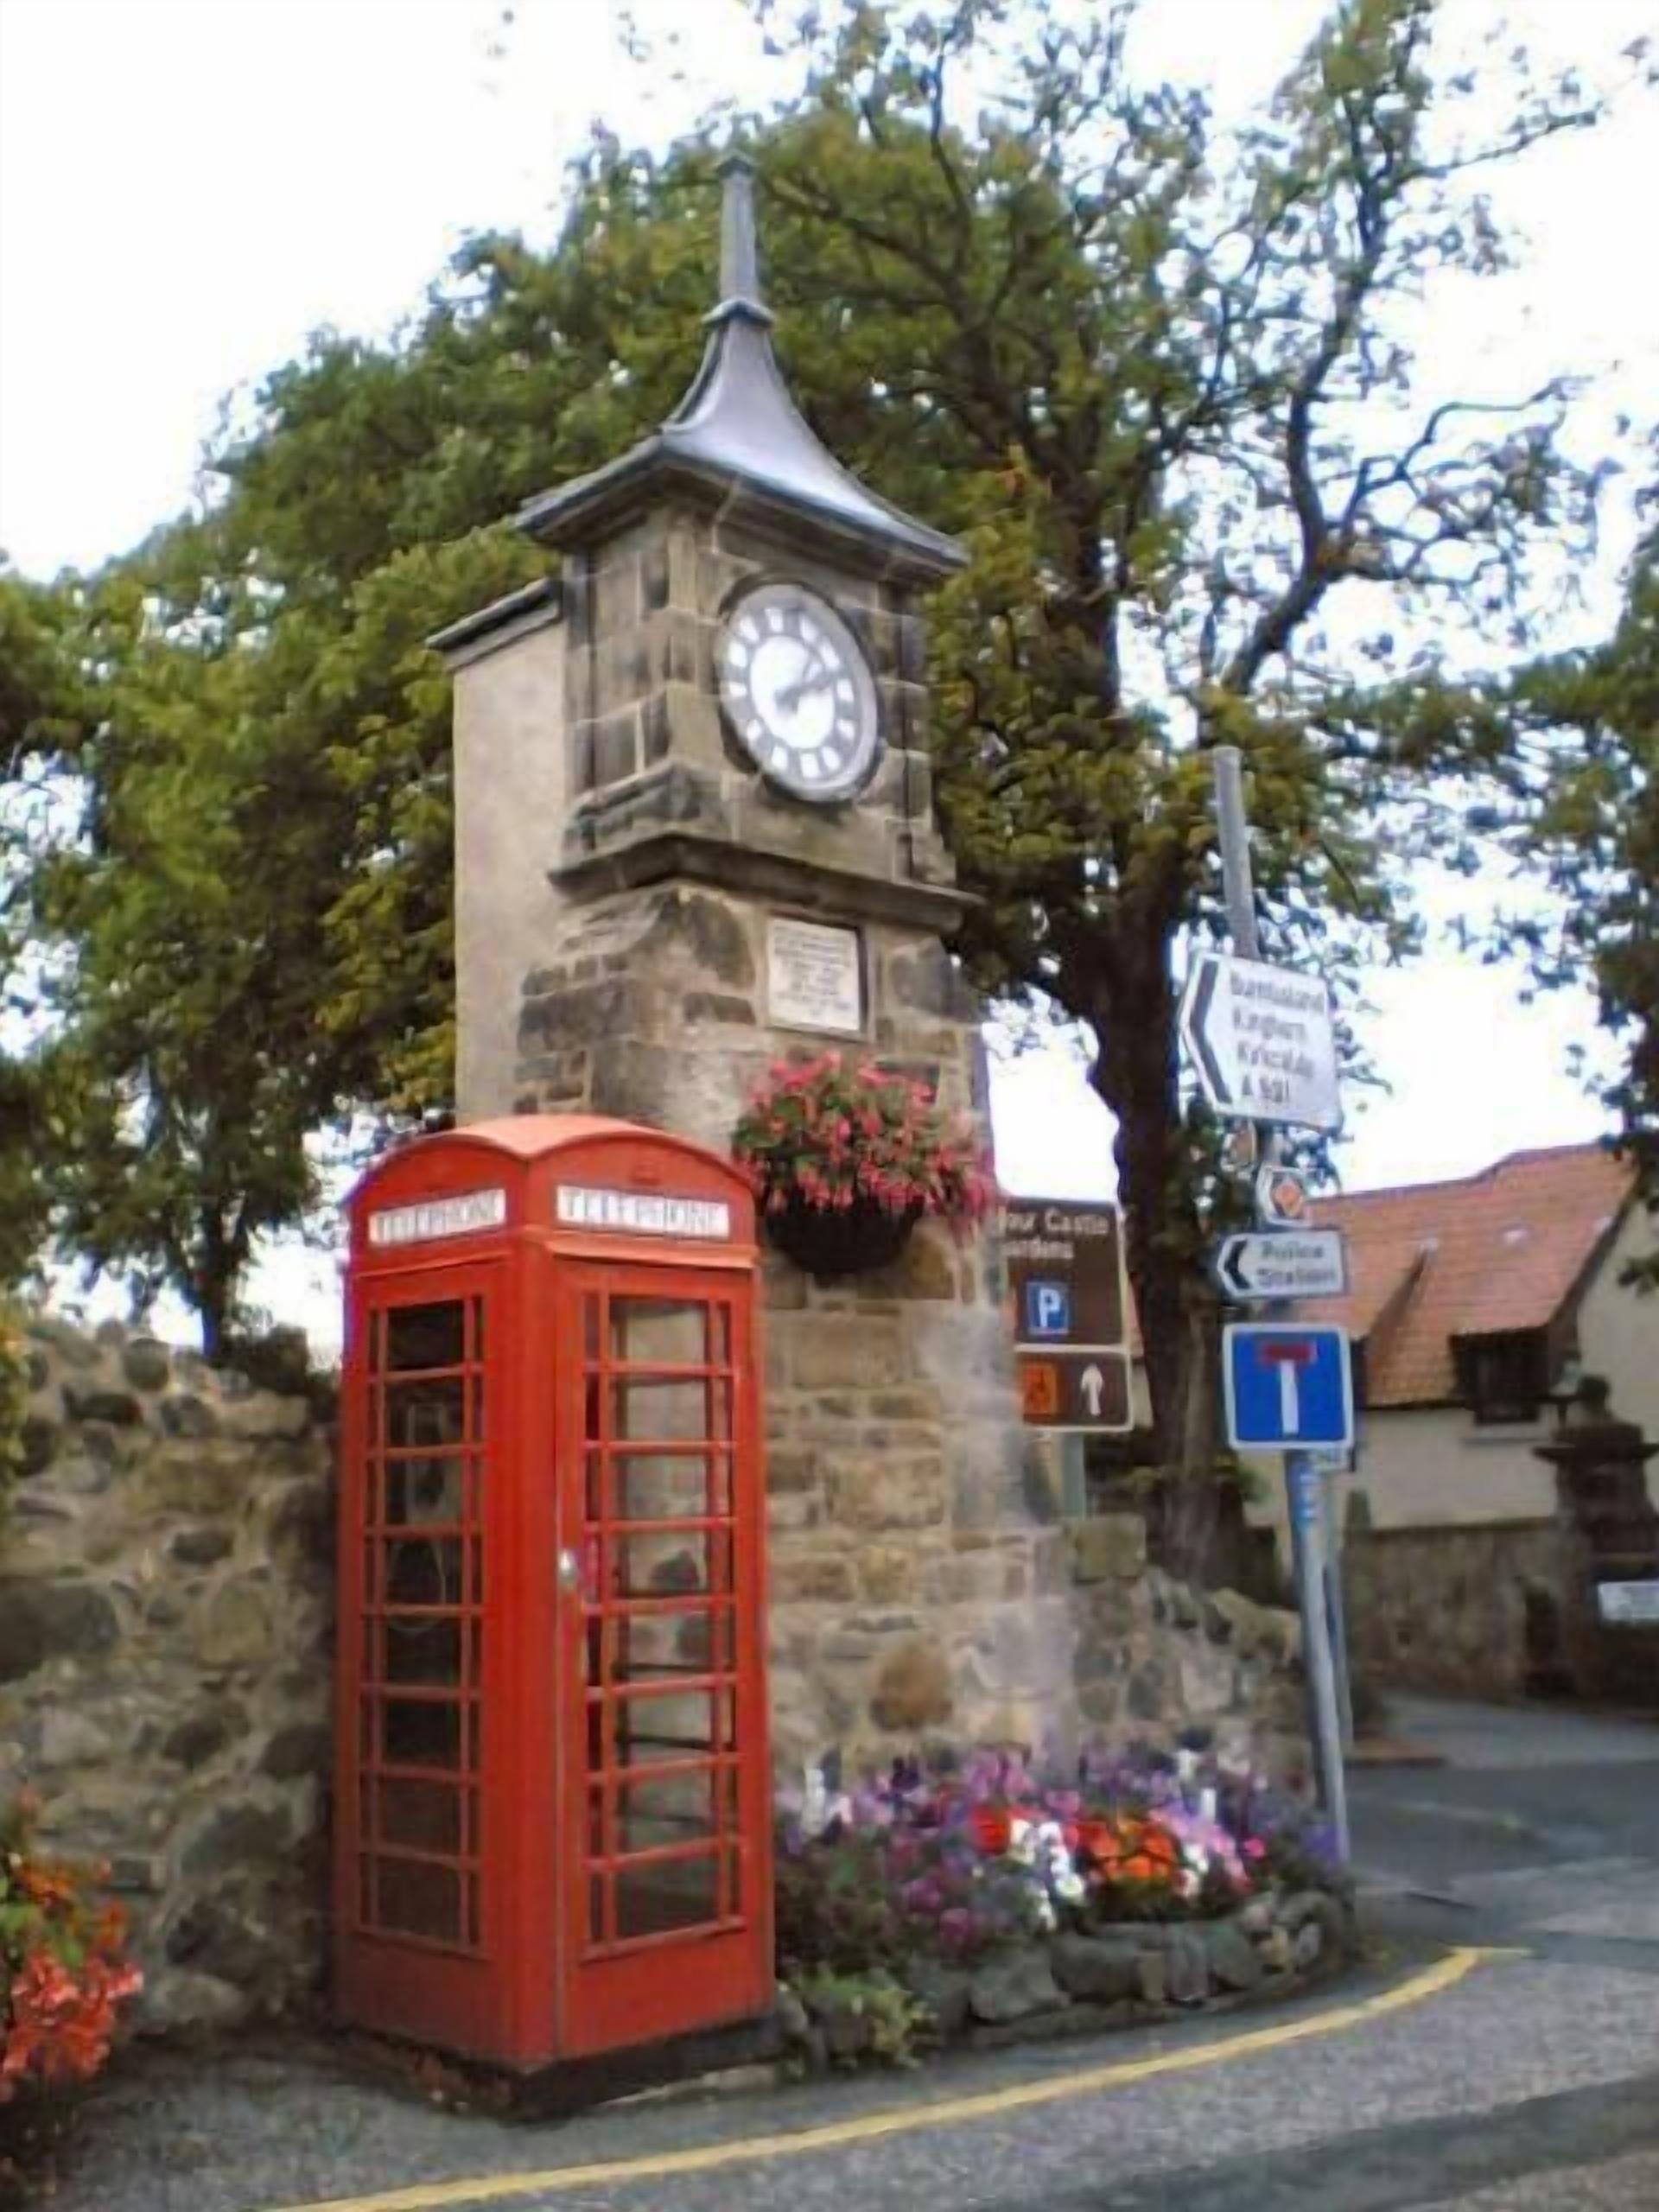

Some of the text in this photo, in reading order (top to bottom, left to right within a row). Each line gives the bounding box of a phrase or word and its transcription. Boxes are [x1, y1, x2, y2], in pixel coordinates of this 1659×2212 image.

[562, 1187, 723, 1236] TELEPHONE
[1044, 1207, 1109, 1236] Castle
[1262, 1240, 1324, 1260] Police
[1257, 1267, 1336, 1287] Station
[1038, 1287, 1060, 1328] P
